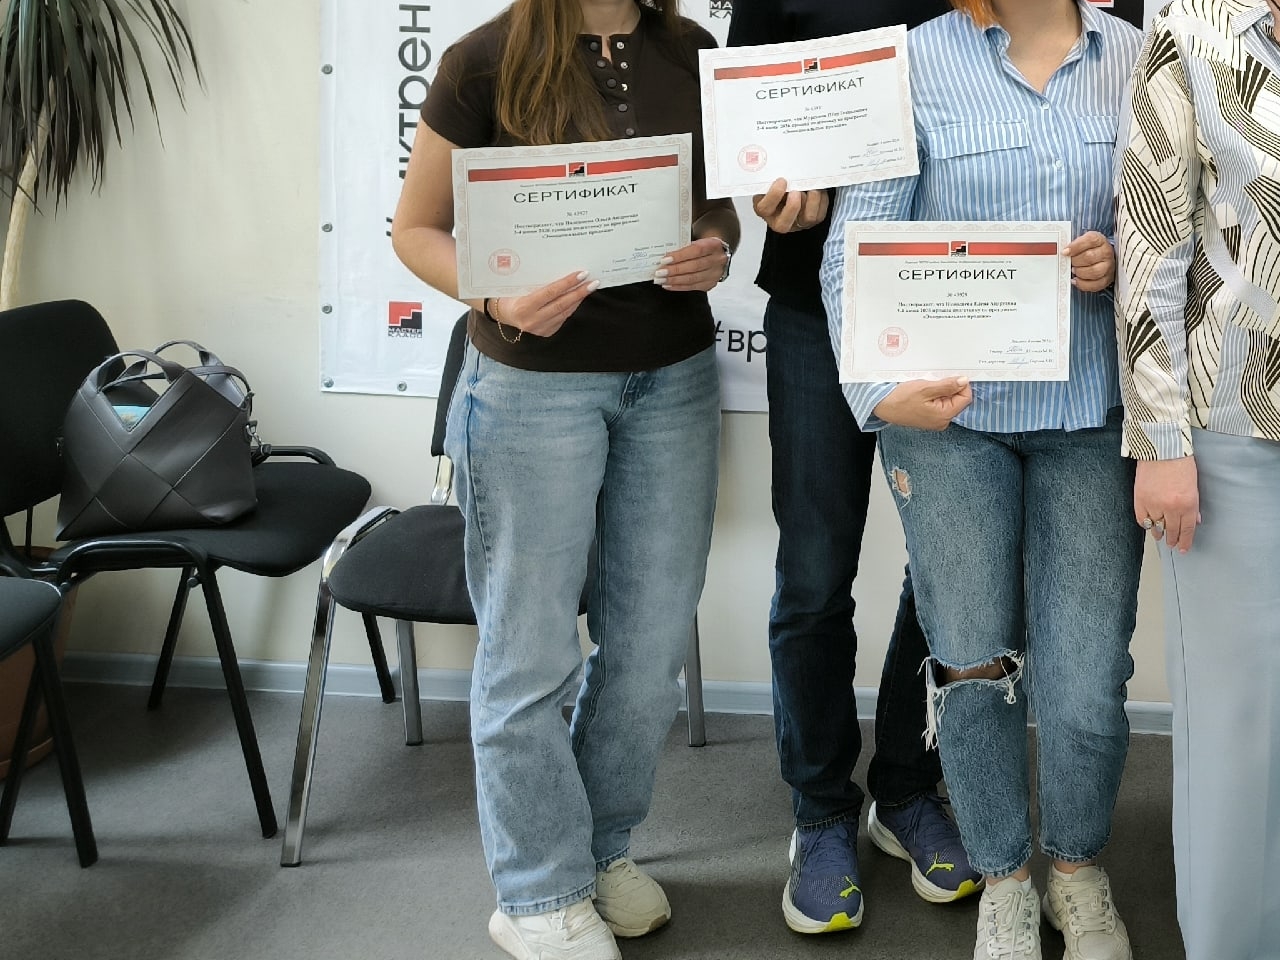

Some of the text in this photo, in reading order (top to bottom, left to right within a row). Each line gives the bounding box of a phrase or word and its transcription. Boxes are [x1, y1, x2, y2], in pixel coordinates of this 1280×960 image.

[755, 77, 865, 100] СЕРТИФИКАТ
[513, 183, 638, 204] СЕРТИФИКАТ
[898, 269, 1017, 281] СЕРТИФИКАТ
